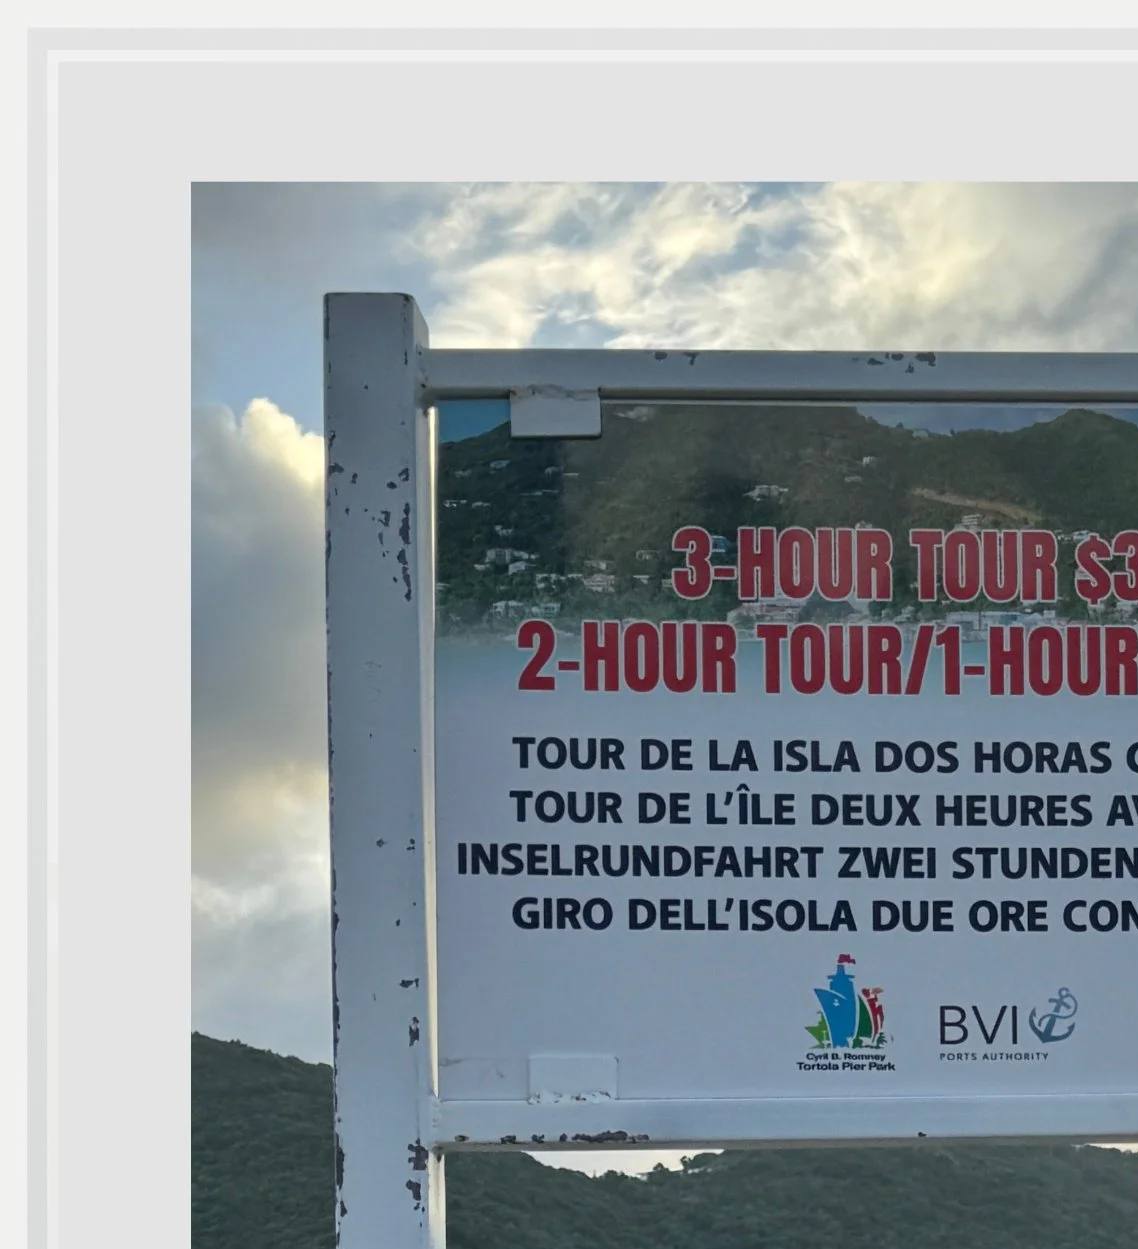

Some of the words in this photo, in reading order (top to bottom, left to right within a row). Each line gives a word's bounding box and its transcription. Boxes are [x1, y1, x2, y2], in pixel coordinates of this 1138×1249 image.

[673, 528, 891, 601] 3-HOUR
[920, 531, 1056, 601] TOUR
[518, 620, 737, 694] 2-HOUR
[756, 624, 1138, 696] TOUR/1-HOUR
[510, 735, 627, 772] TOUR
[639, 737, 695, 772] DE
[707, 738, 760, 773] LA
[772, 738, 862, 774] ISLA
[874, 739, 961, 775] DOS
[973, 740, 1114, 775] HORAS
[508, 789, 624, 825] TOUR
[637, 791, 693, 826] DE
[810, 792, 923, 828] DEUX
[934, 793, 1094, 828] HEURES
[456, 841, 825, 880] INSELRUNDFAHRT
[836, 845, 938, 880] ZWEI
[511, 895, 615, 932] GIRO
[627, 896, 859, 933] DELL’ISOLA
[871, 899, 955, 934] DUE
[967, 898, 1050, 934] ORE
[938, 1004, 1019, 1046] BVI
[795, 1061, 840, 1071] Tortola
[841, 1061, 867, 1071] Pier
[868, 1061, 896, 1071] Park
[805, 1052, 829, 1062] Cyril
[843, 1052, 886, 1062] Romney
[939, 1052, 978, 1061] PORTS
[982, 1052, 1049, 1061] AUTHORITY
